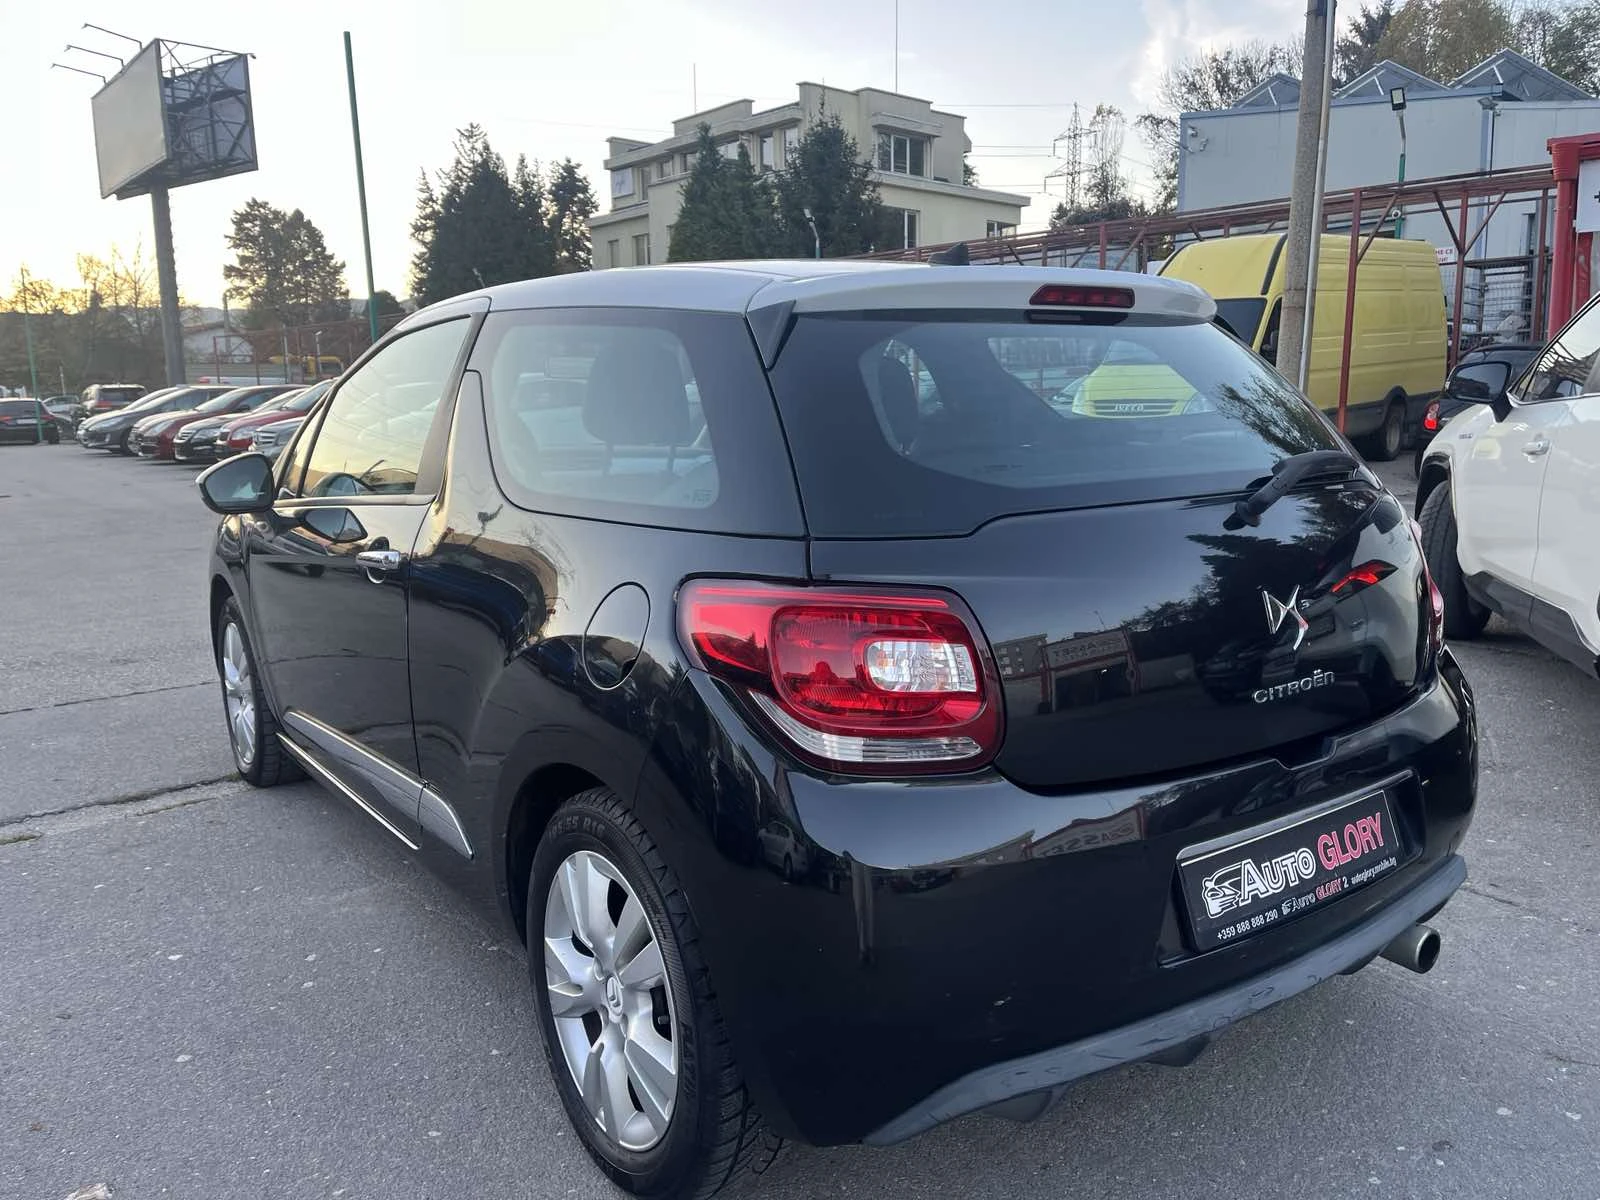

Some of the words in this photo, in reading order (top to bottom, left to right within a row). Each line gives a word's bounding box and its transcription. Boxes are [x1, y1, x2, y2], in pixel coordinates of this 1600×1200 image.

[1317, 812, 1385, 871] GLORY
[1217, 925, 1236, 940] +359
[1237, 920, 1251, 934] 888
[1251, 914, 1265, 929] 888
[1265, 909, 1279, 922] 290
[1316, 877, 1342, 900] GLORY
[1342, 876, 1349, 889] 2
